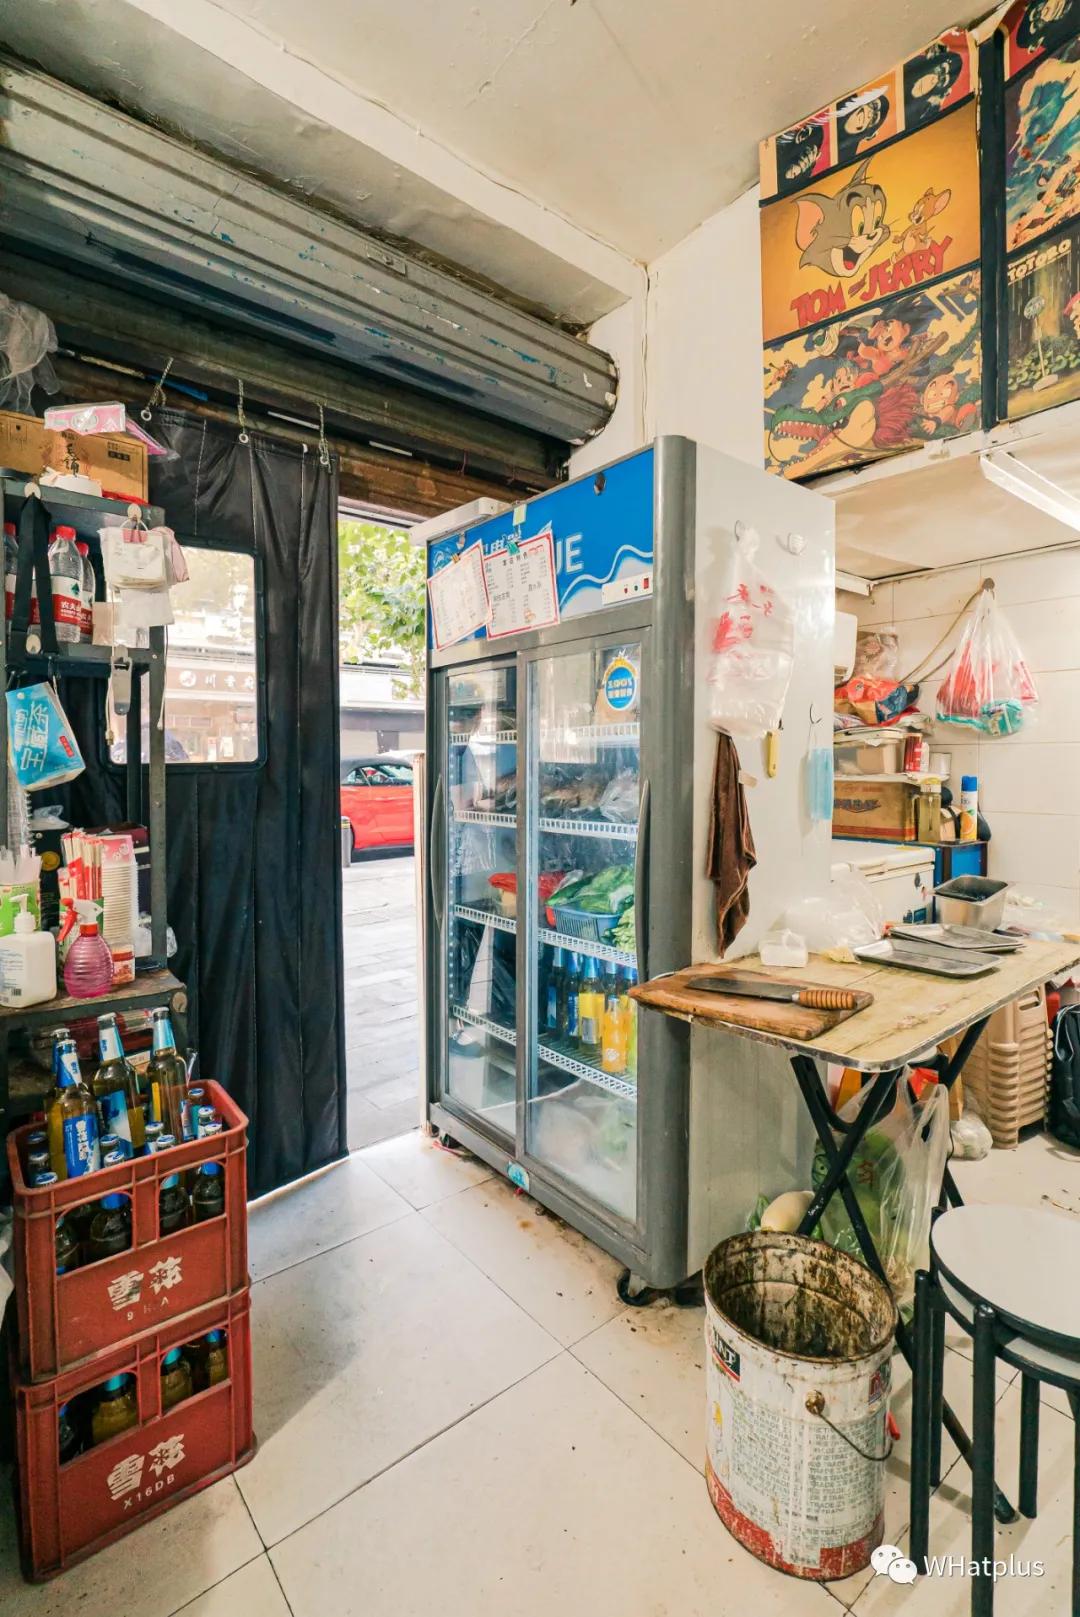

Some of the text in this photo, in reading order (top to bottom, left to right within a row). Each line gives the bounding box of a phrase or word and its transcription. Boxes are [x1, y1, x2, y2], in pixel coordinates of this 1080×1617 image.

[860, 235, 953, 302] JERRY
[1007, 239, 1072, 282] TOTORO
[790, 281, 847, 327] TOM
